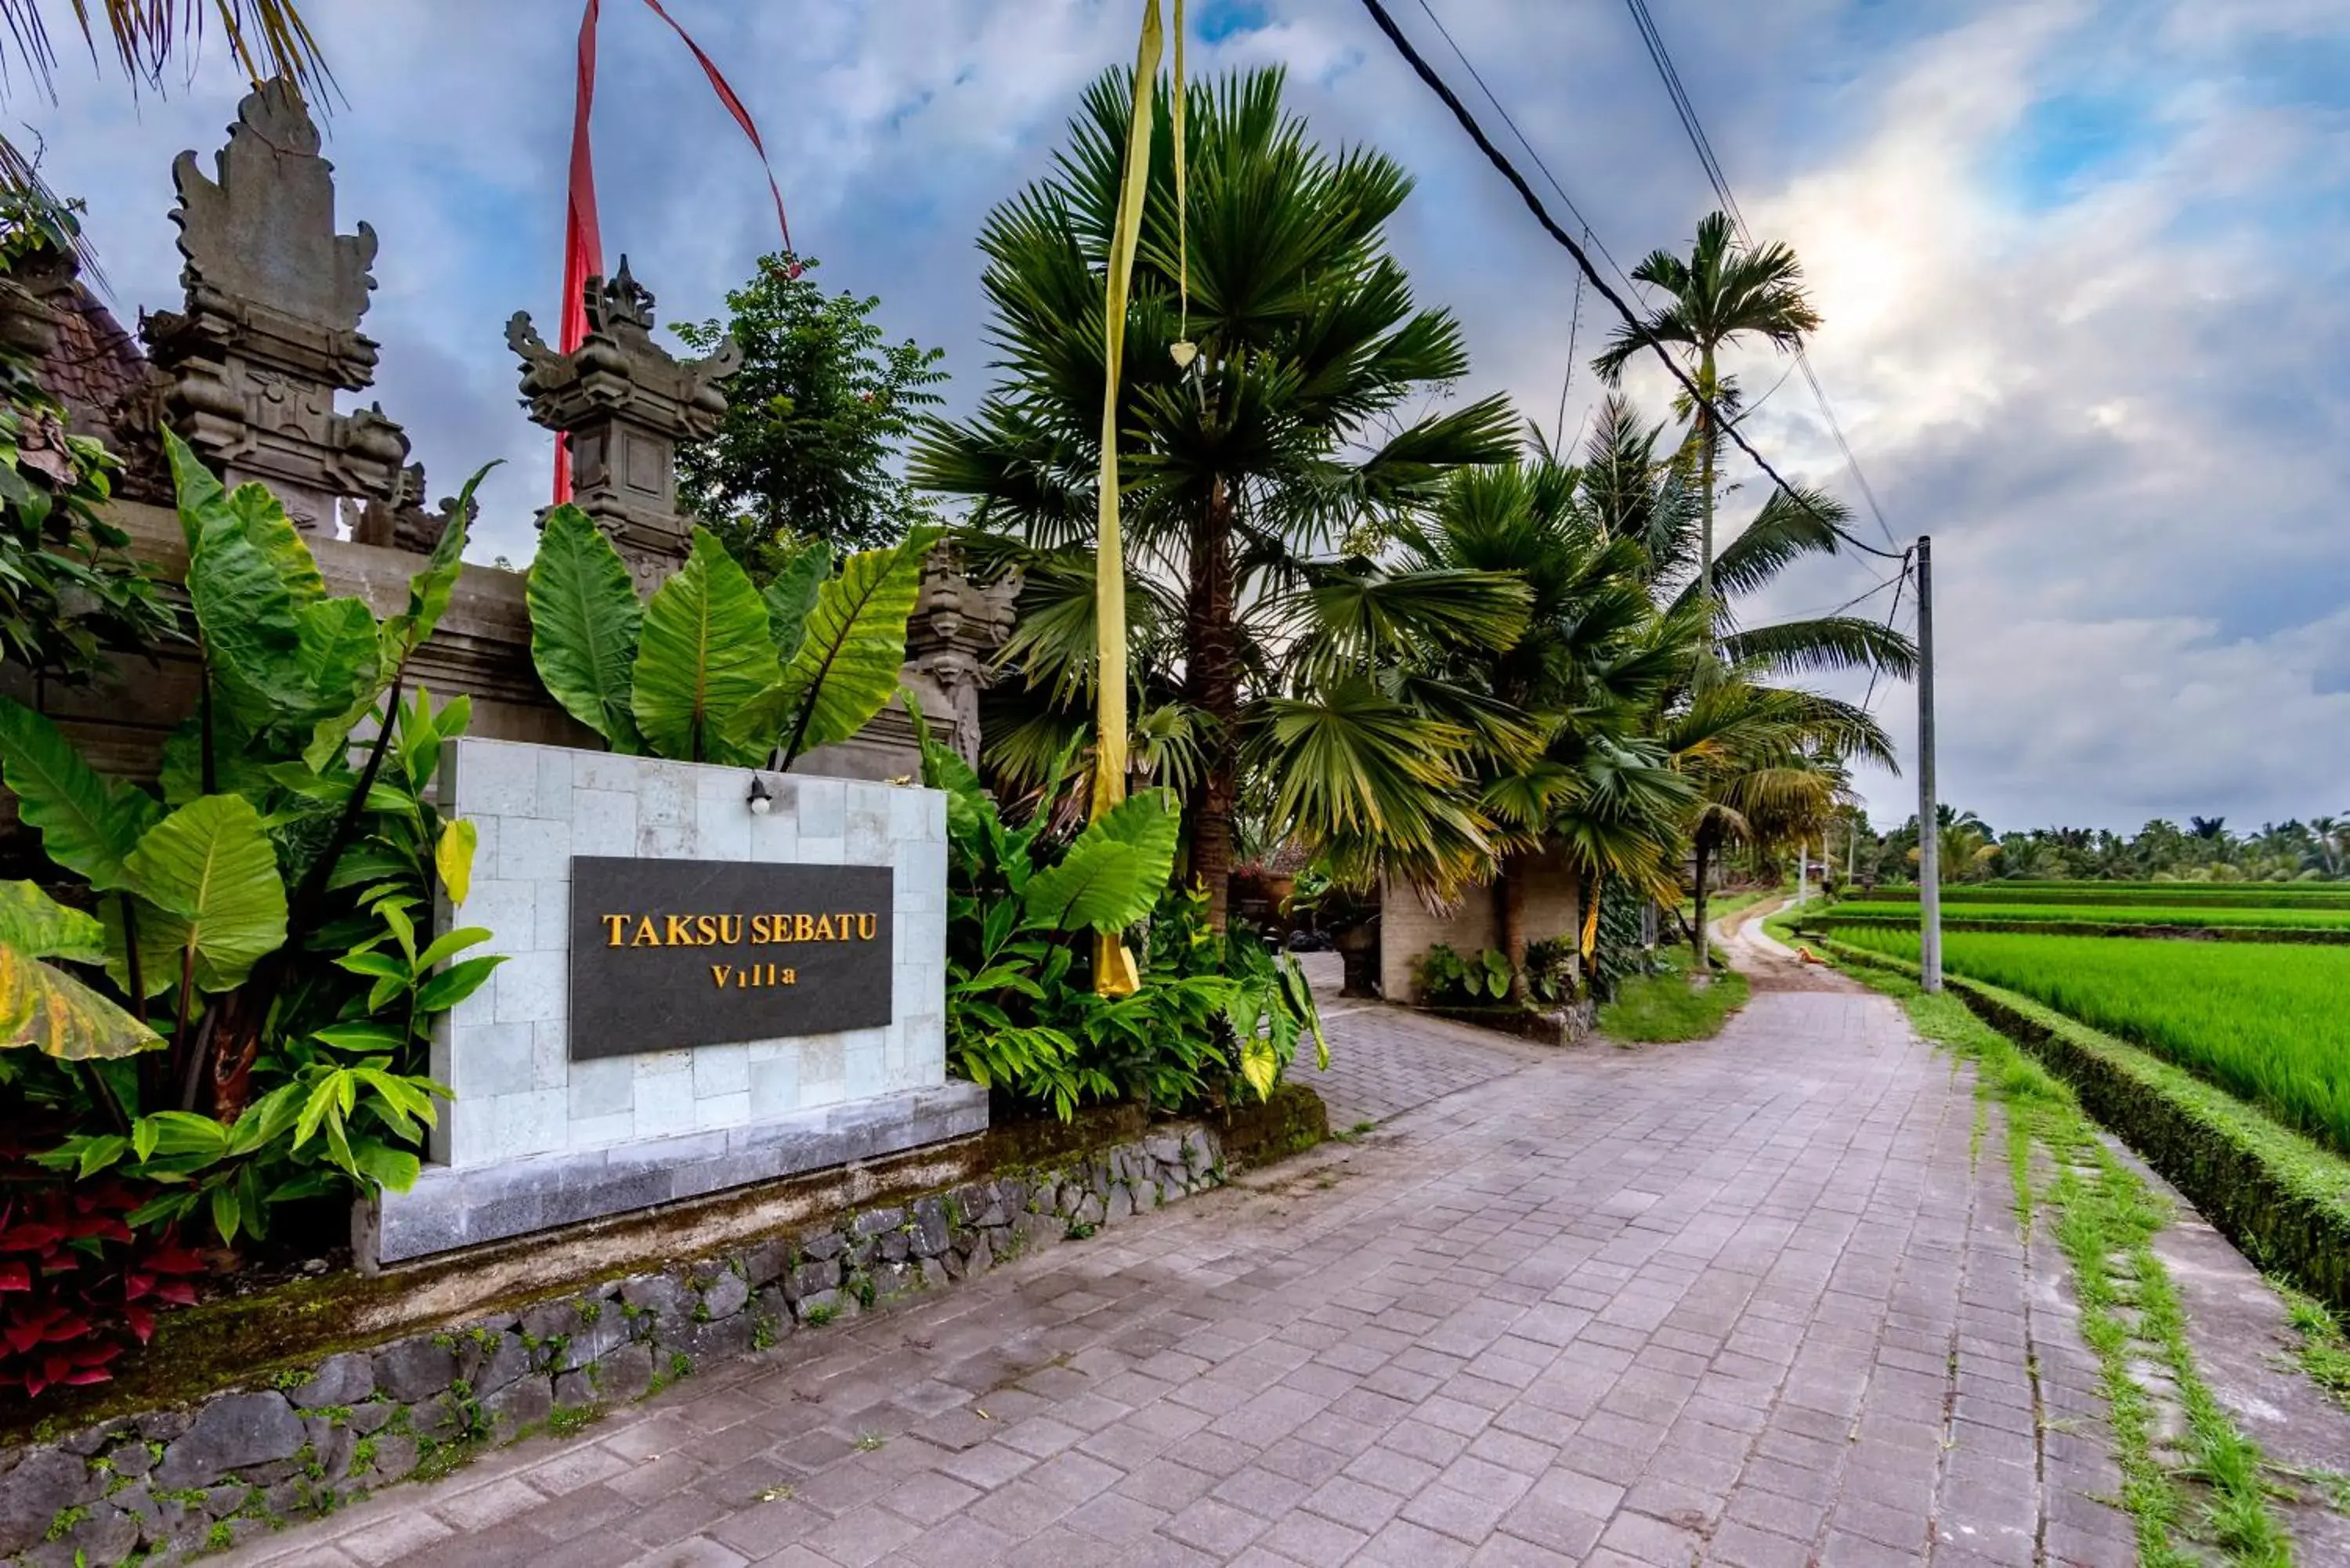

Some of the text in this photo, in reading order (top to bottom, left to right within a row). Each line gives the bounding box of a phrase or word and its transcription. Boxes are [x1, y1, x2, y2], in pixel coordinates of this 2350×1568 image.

[602, 912, 877, 947] TAKSU SEBATU
[711, 964, 797, 988] Villa
